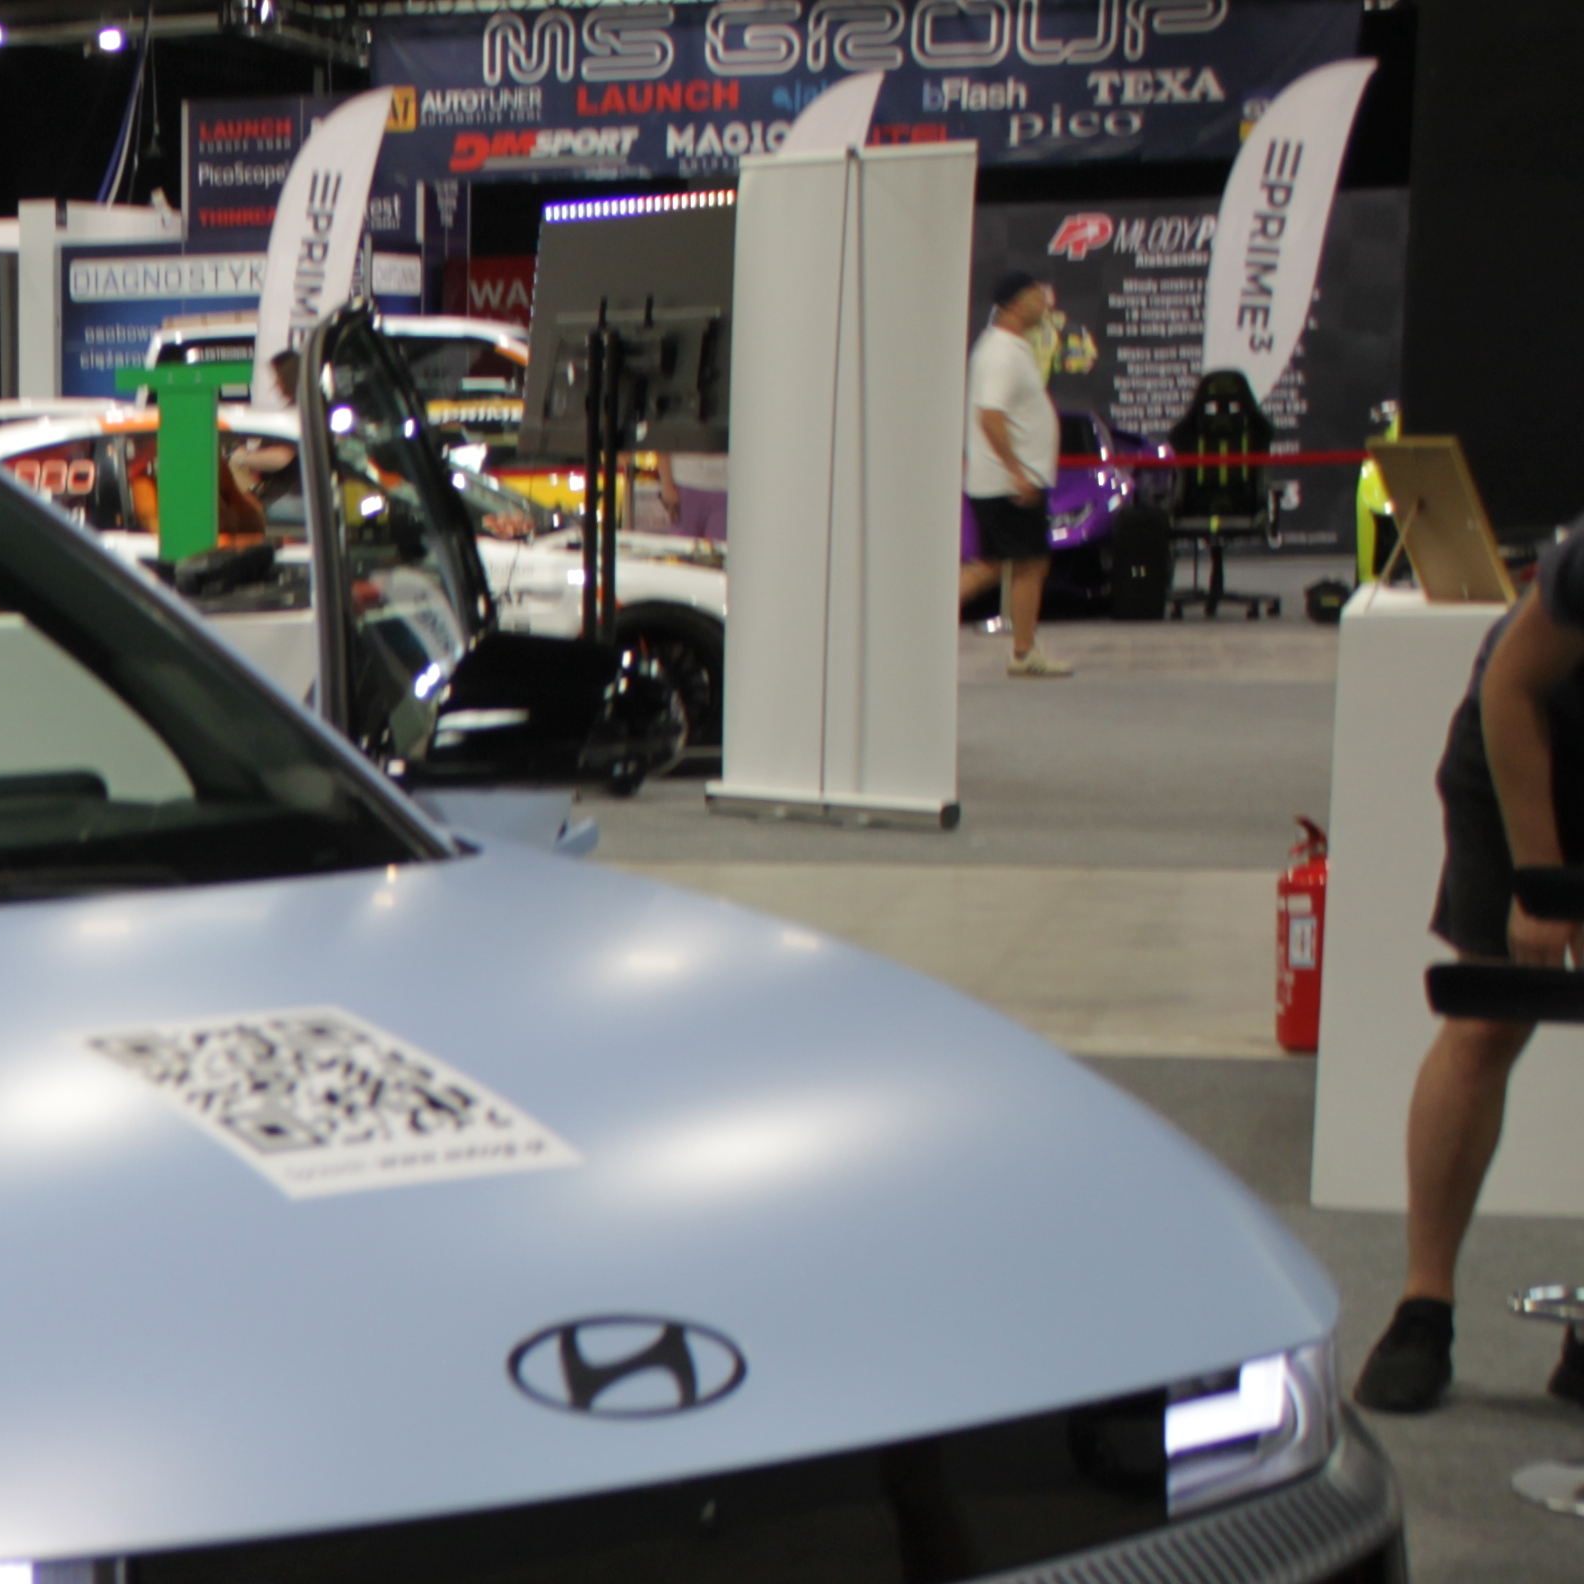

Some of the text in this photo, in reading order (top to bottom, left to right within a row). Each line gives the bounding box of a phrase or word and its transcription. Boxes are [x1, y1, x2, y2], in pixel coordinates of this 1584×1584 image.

[482, 4, 675, 87] MS
[420, 87, 543, 115] AUTOTUNER
[577, 79, 740, 117] LAUNCH
[922, 76, 1028, 113] bFlash
[1087, 66, 1226, 106] TEXA
[199, 117, 293, 143] LAUNCH
[1008, 102, 1144, 148] pico
